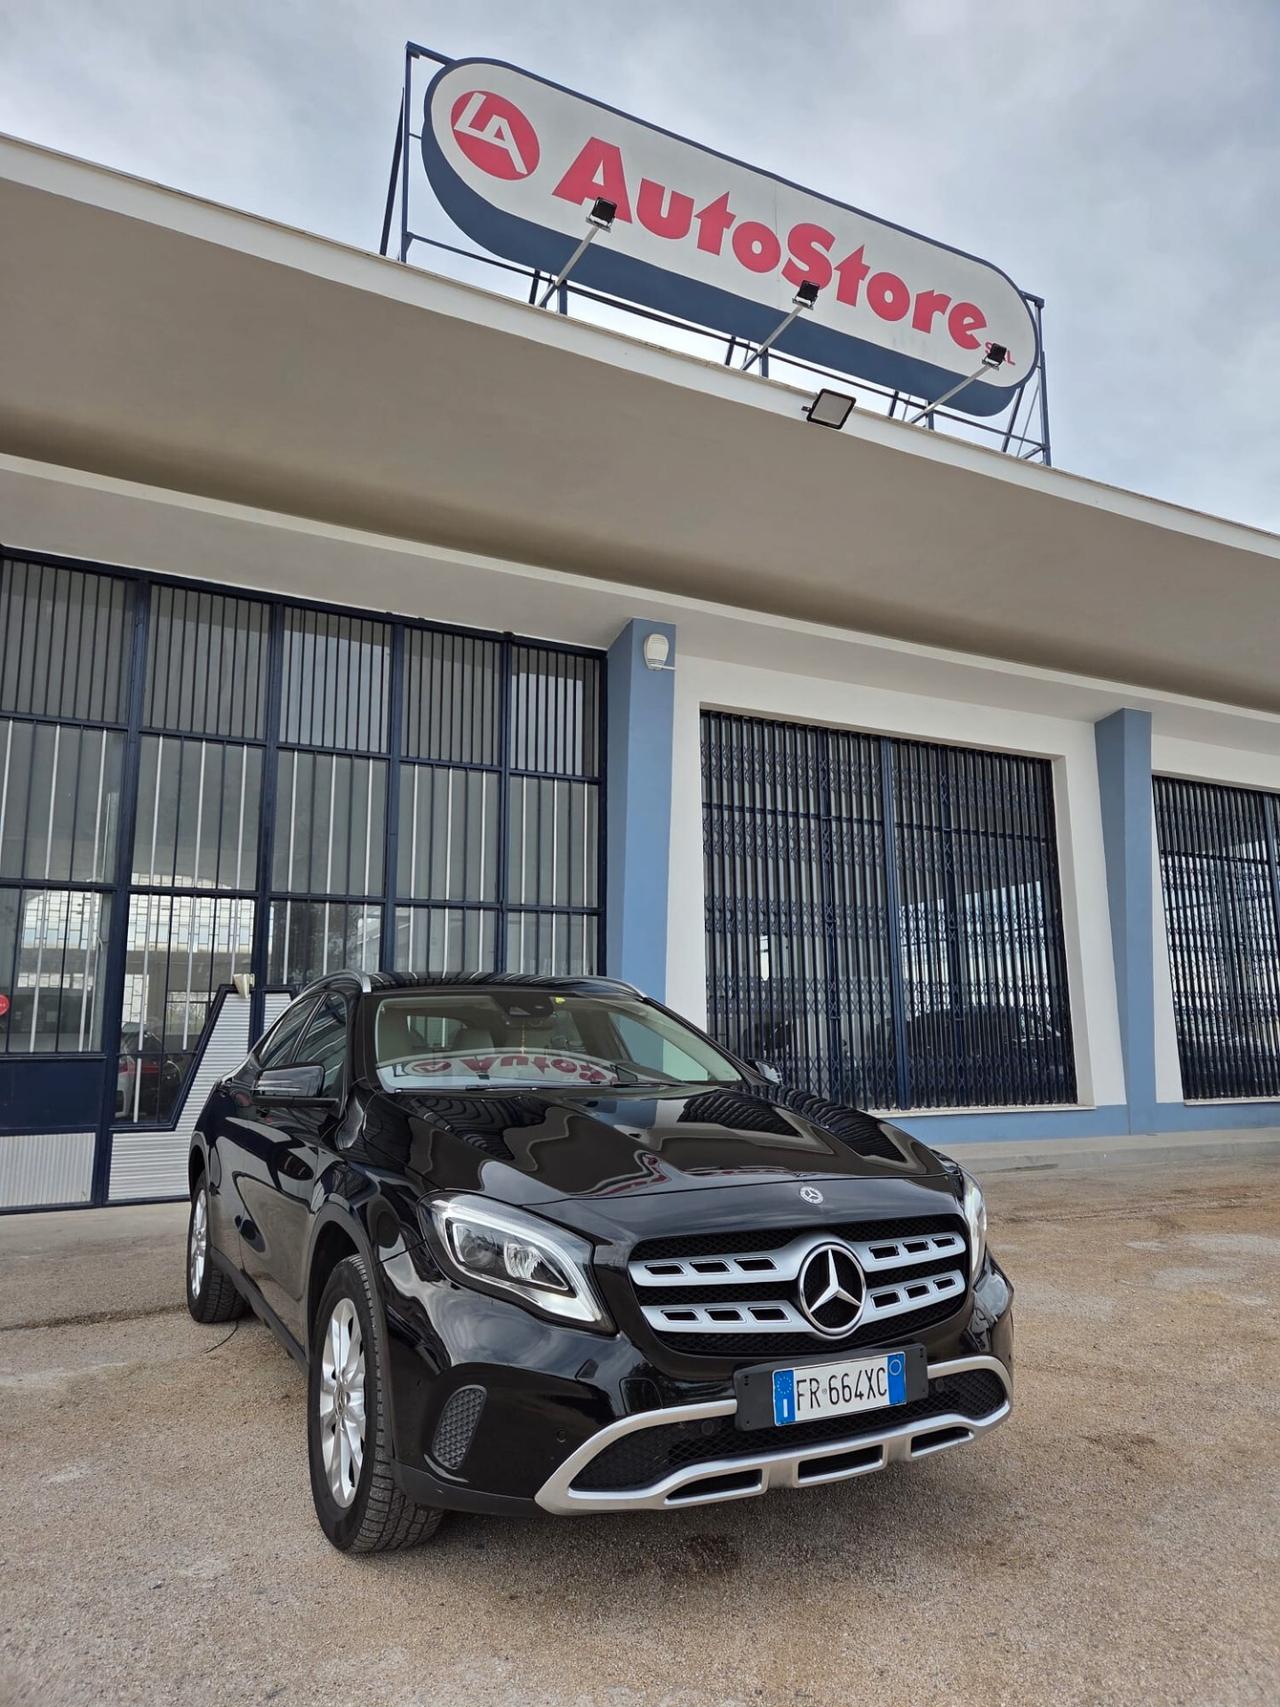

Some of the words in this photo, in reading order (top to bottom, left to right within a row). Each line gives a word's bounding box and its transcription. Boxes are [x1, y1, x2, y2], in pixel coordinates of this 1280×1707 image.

[453, 92, 528, 175] LA
[552, 137, 987, 351] AutoStore
[984, 341, 1017, 366] SL
[796, 1377, 821, 1411] FR
[828, 1367, 887, 1405] 664XC
